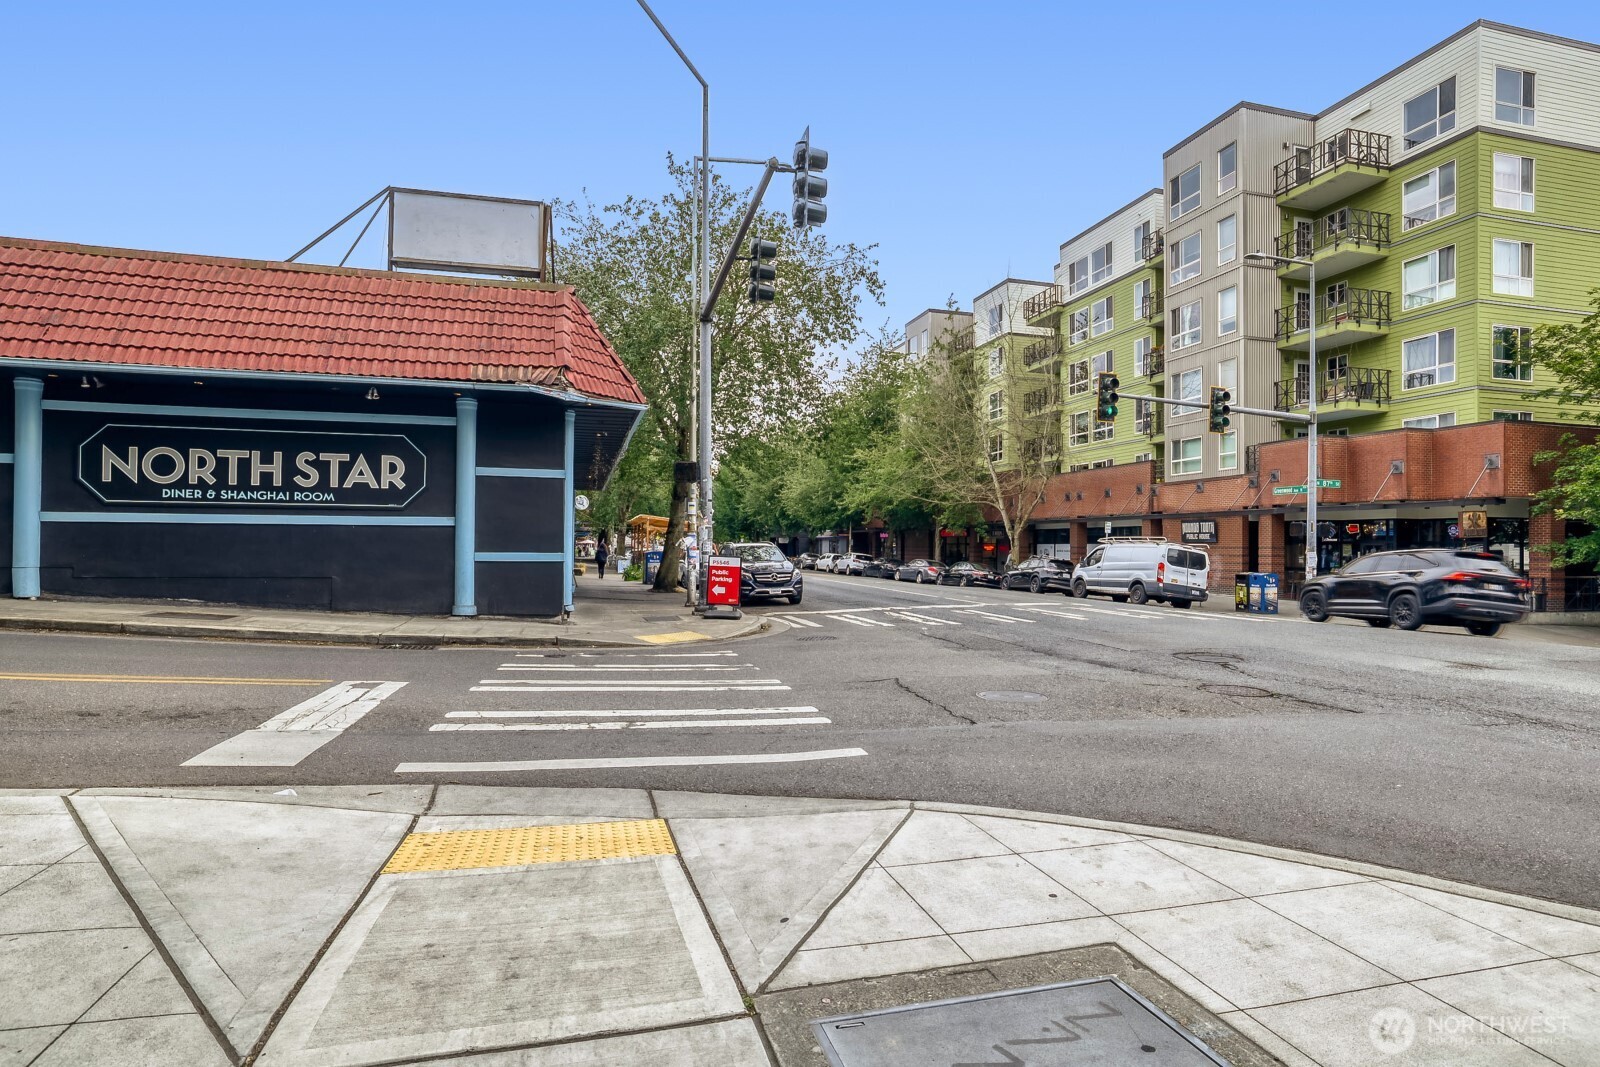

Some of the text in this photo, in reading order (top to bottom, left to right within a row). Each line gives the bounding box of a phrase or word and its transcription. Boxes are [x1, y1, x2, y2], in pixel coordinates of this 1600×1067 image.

[102, 444, 406, 490] NORTH STAR
[162, 488, 335, 501] DINER & SHANGHAI ROOM
